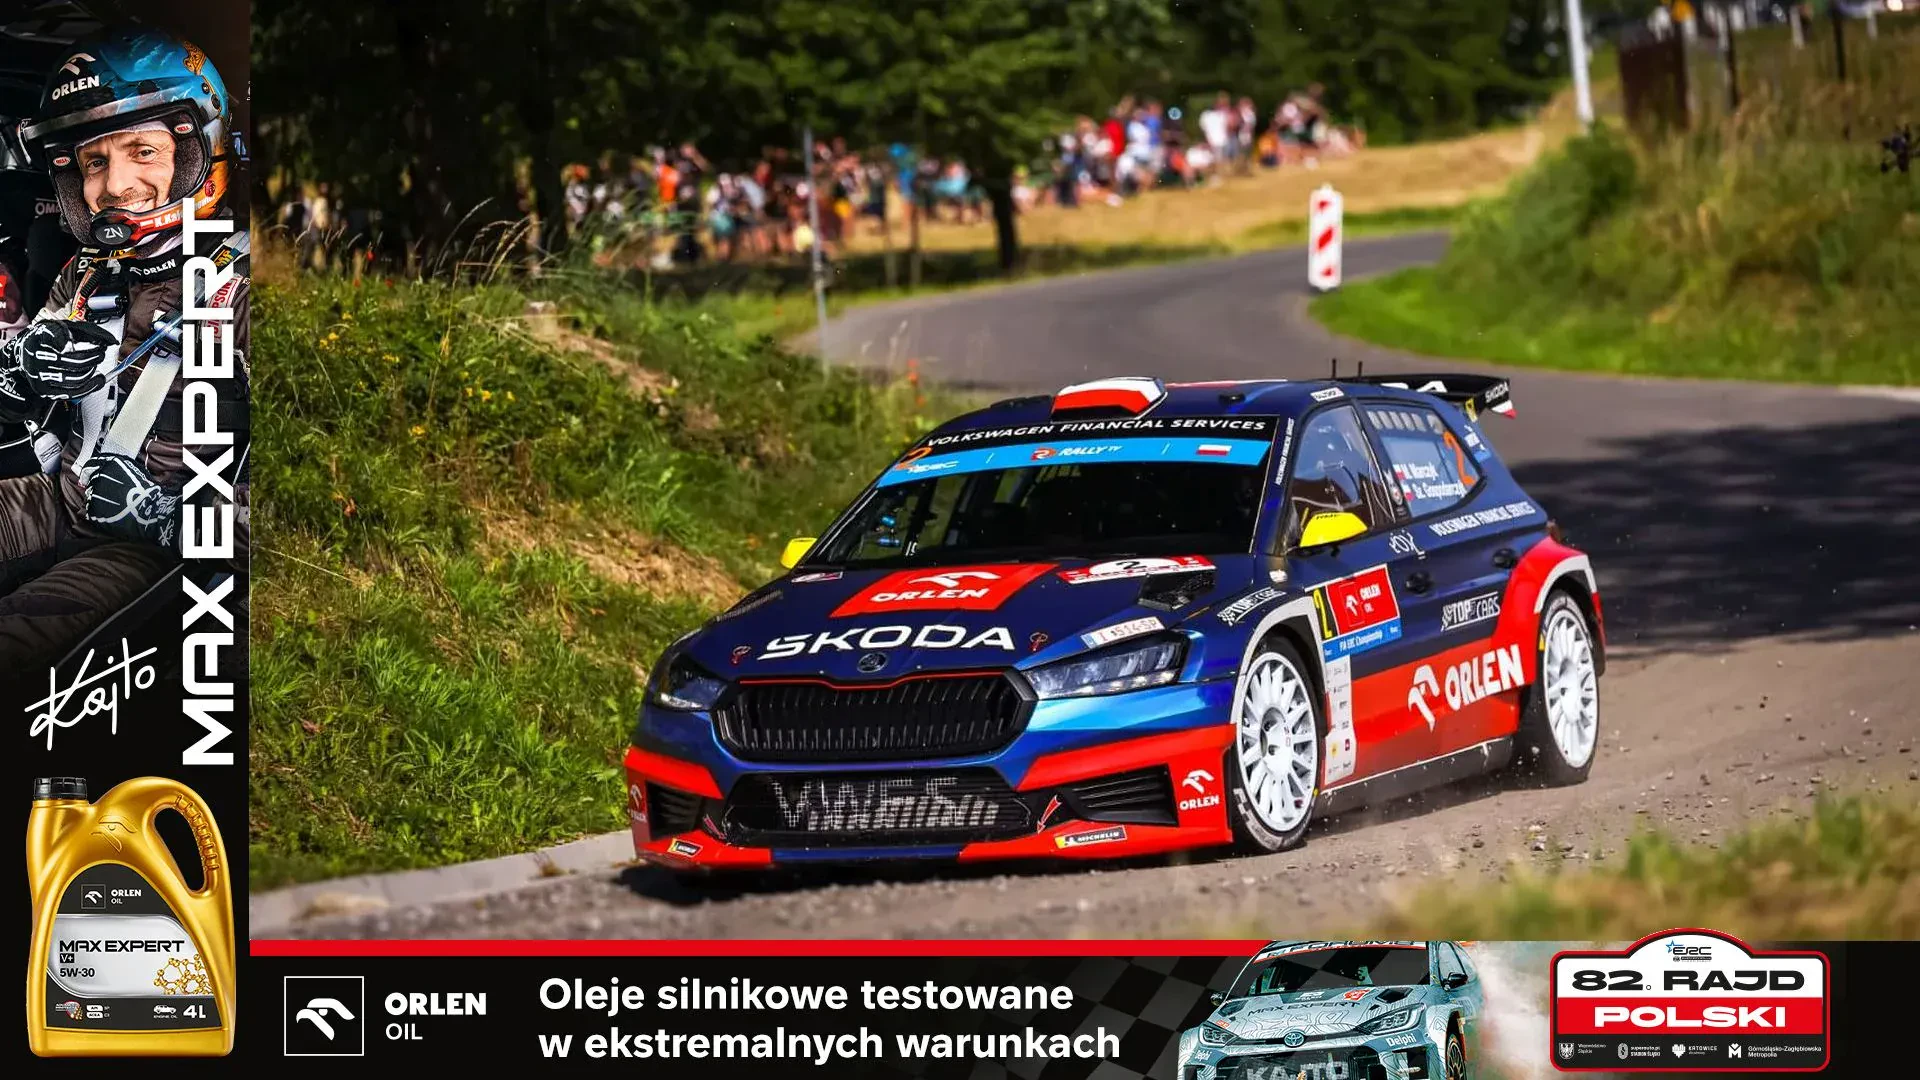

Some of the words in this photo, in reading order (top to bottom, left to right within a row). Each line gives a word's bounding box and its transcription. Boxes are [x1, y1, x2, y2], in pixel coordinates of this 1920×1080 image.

[52, 75, 100, 101] ORLEN
[143, 259, 176, 276] ORLEN
[928, 425, 1054, 446] VOLKSWAGEN
[1060, 418, 1165, 433] FINANCIAL
[1170, 419, 1267, 430] SERVICES
[1442, 431, 1477, 487] 2
[871, 588, 989, 602] ORLEN
[1313, 588, 1333, 639] 2
[1445, 644, 1525, 711] ORLEN
[1180, 795, 1220, 810] ORLEN
[1077, 832, 1120, 842] MICHELIN
[111, 889, 142, 897] ORLEN
[60, 940, 102, 953] MAX
[104, 940, 185, 953] EXPERT
[59, 968, 95, 978] 5W-30
[1248, 1005, 1285, 1017] MAX
[1286, 1001, 1362, 1012] EXPERT
[1386, 1033, 1417, 1047] Delphi
